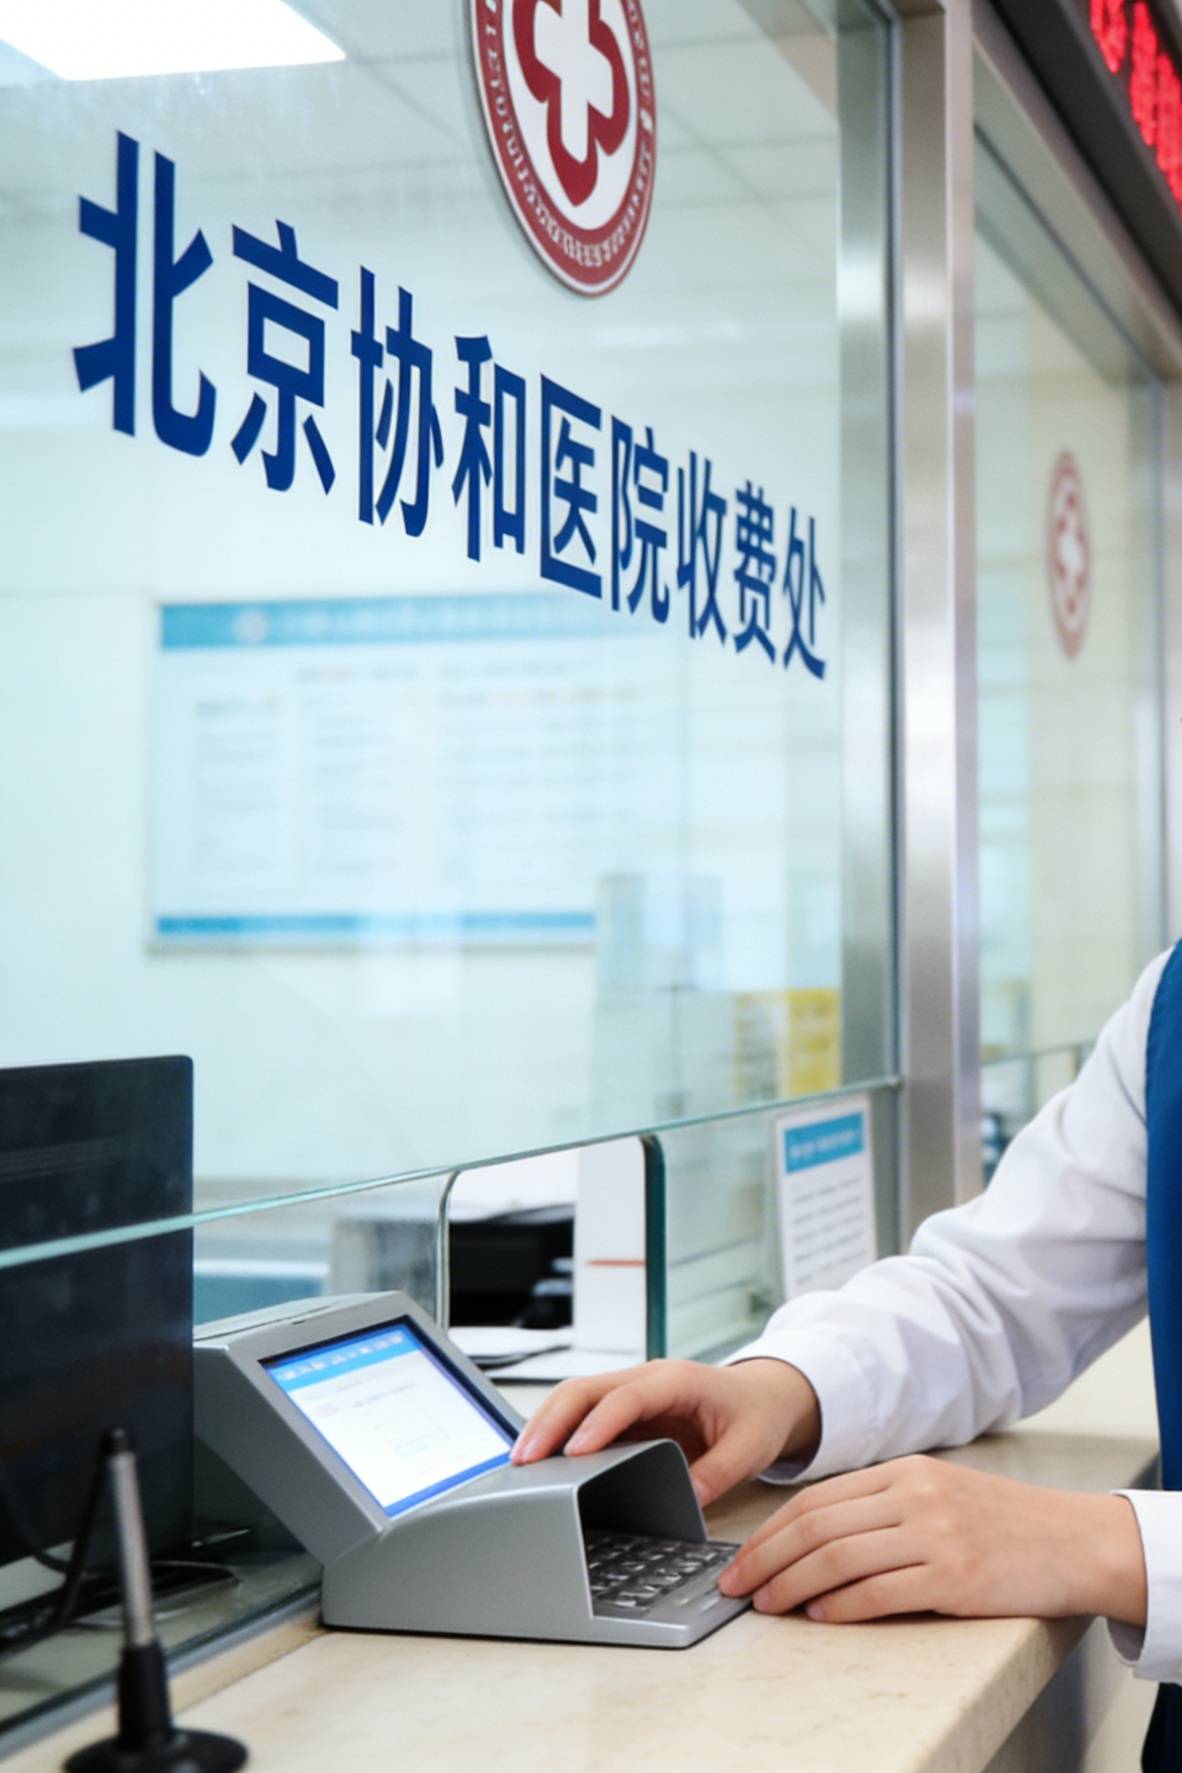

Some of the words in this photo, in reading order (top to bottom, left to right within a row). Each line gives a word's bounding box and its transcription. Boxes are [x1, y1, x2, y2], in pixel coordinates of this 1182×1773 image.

[72, 130, 825, 679] 北京协和医院收费处
